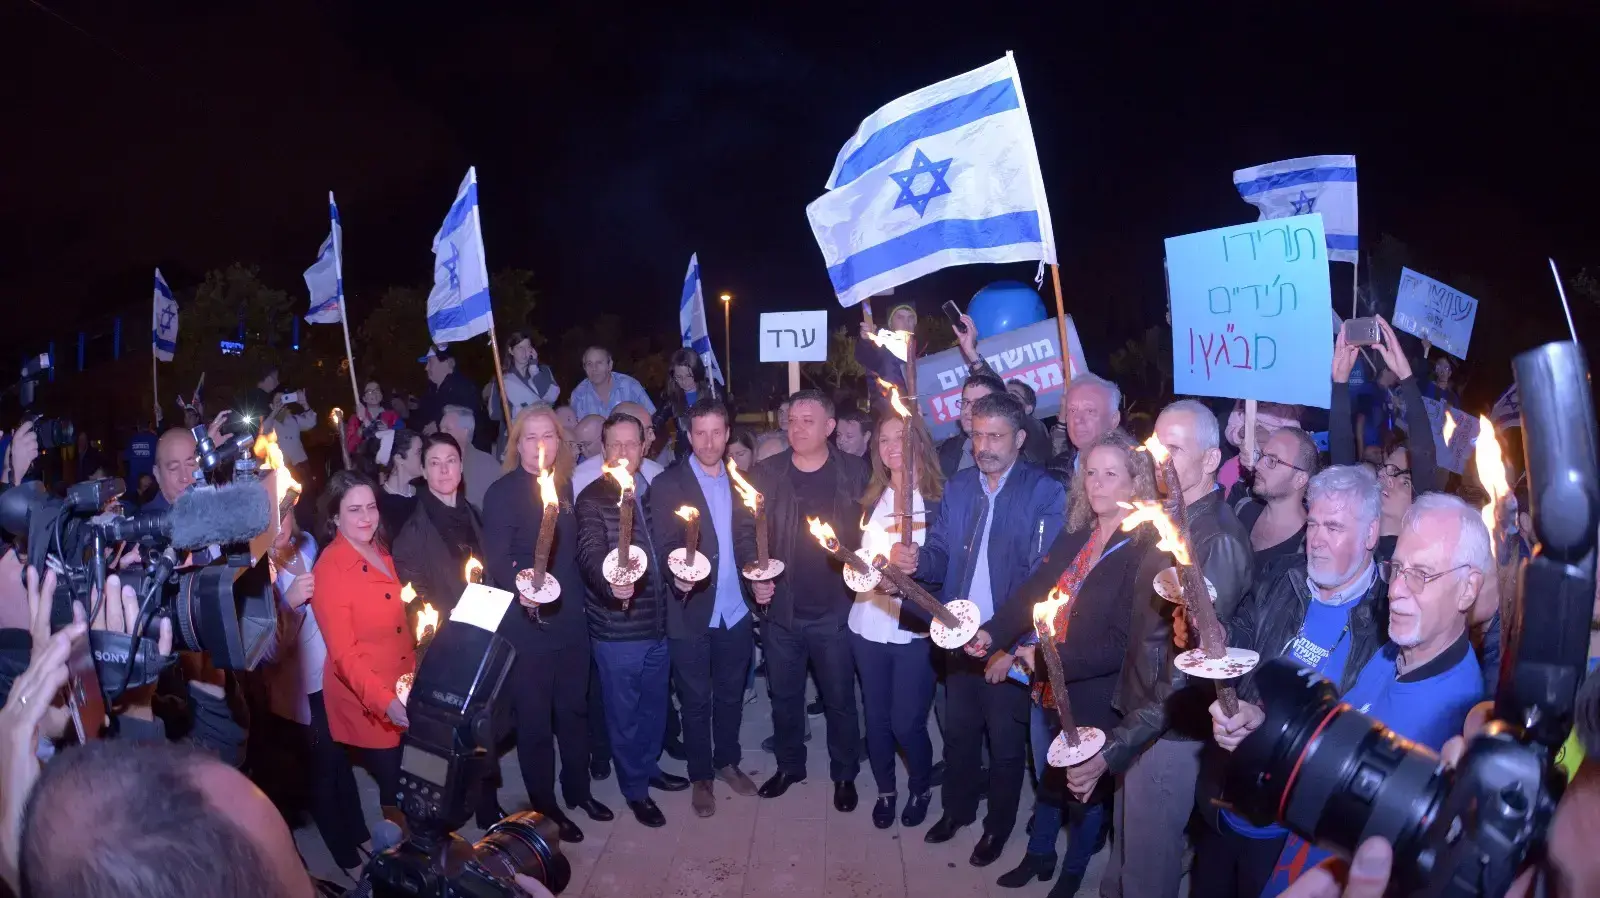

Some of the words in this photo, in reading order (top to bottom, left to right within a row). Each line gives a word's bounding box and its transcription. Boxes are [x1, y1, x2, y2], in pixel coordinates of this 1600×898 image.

[767, 328, 815, 348] ערד
[937, 338, 1055, 390] מושחים
[95, 650, 129, 664] SONY
